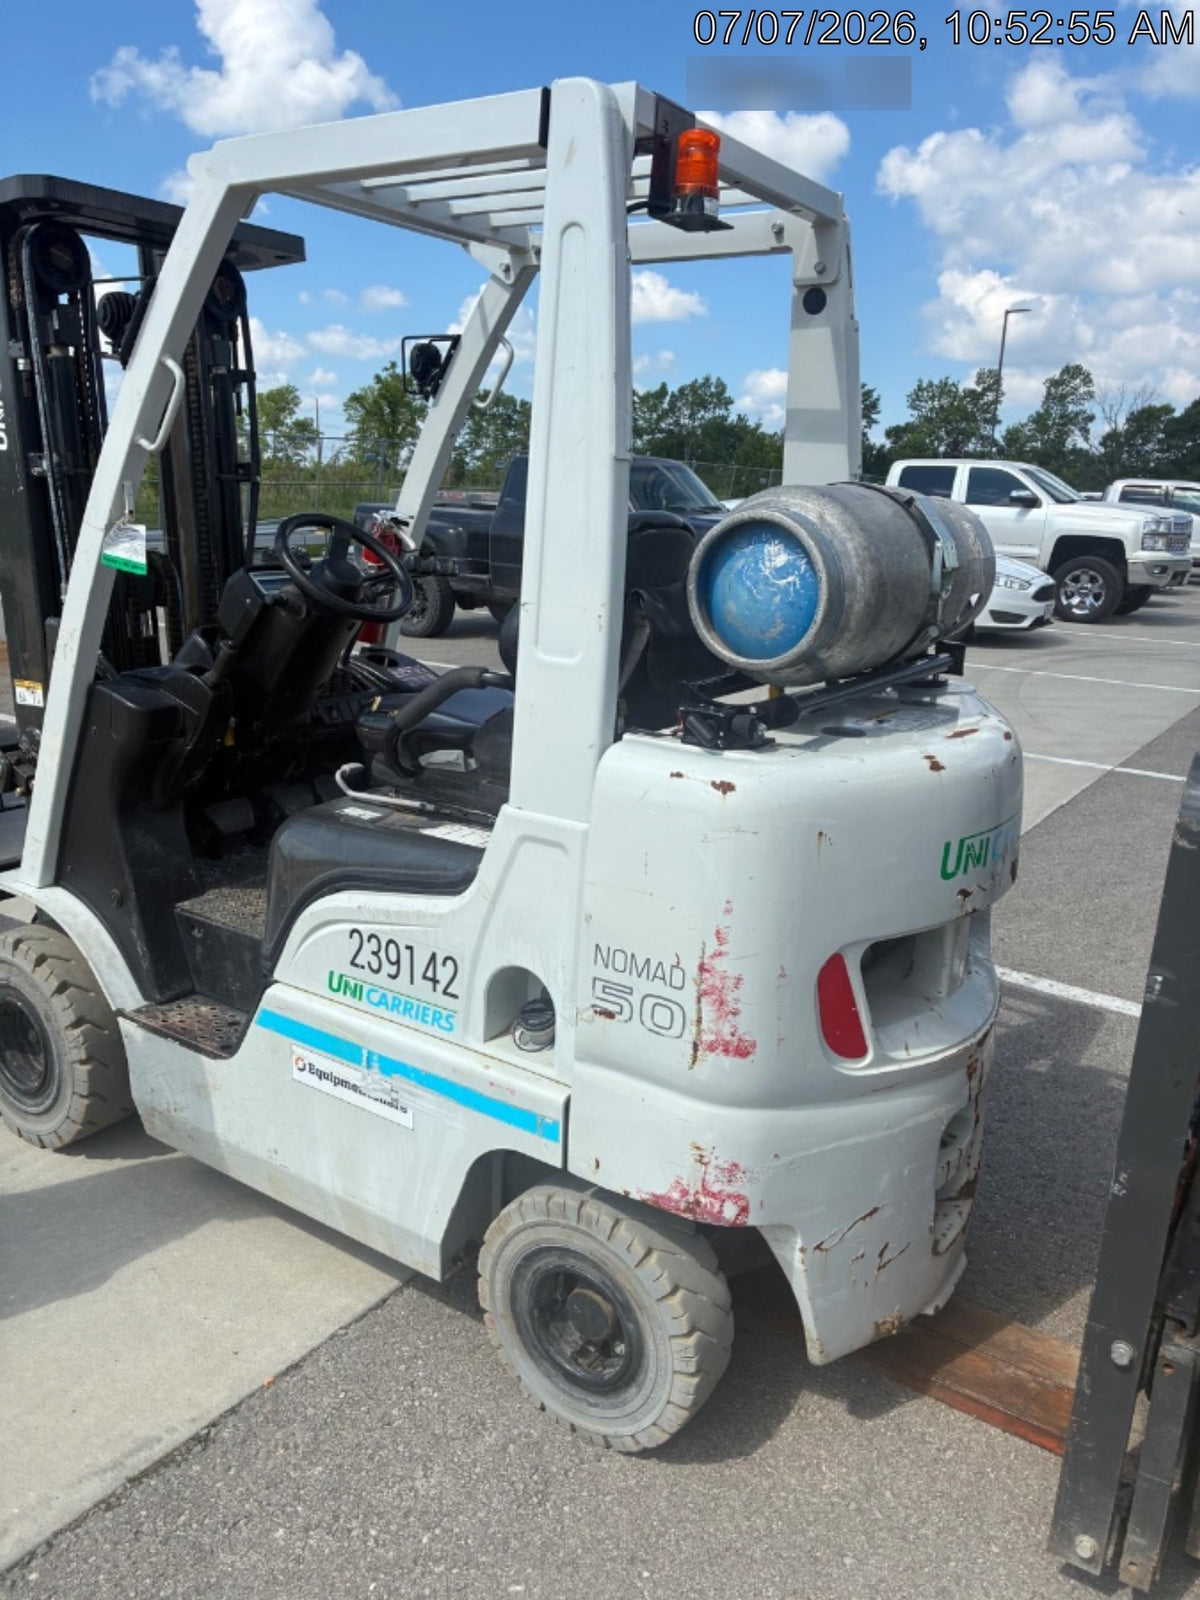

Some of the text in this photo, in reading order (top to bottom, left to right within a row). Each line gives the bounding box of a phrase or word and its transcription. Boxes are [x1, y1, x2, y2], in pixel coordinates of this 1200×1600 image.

[349, 928, 459, 999] 239142
[593, 943, 685, 990] NOMAD
[591, 976, 687, 1039] 50
